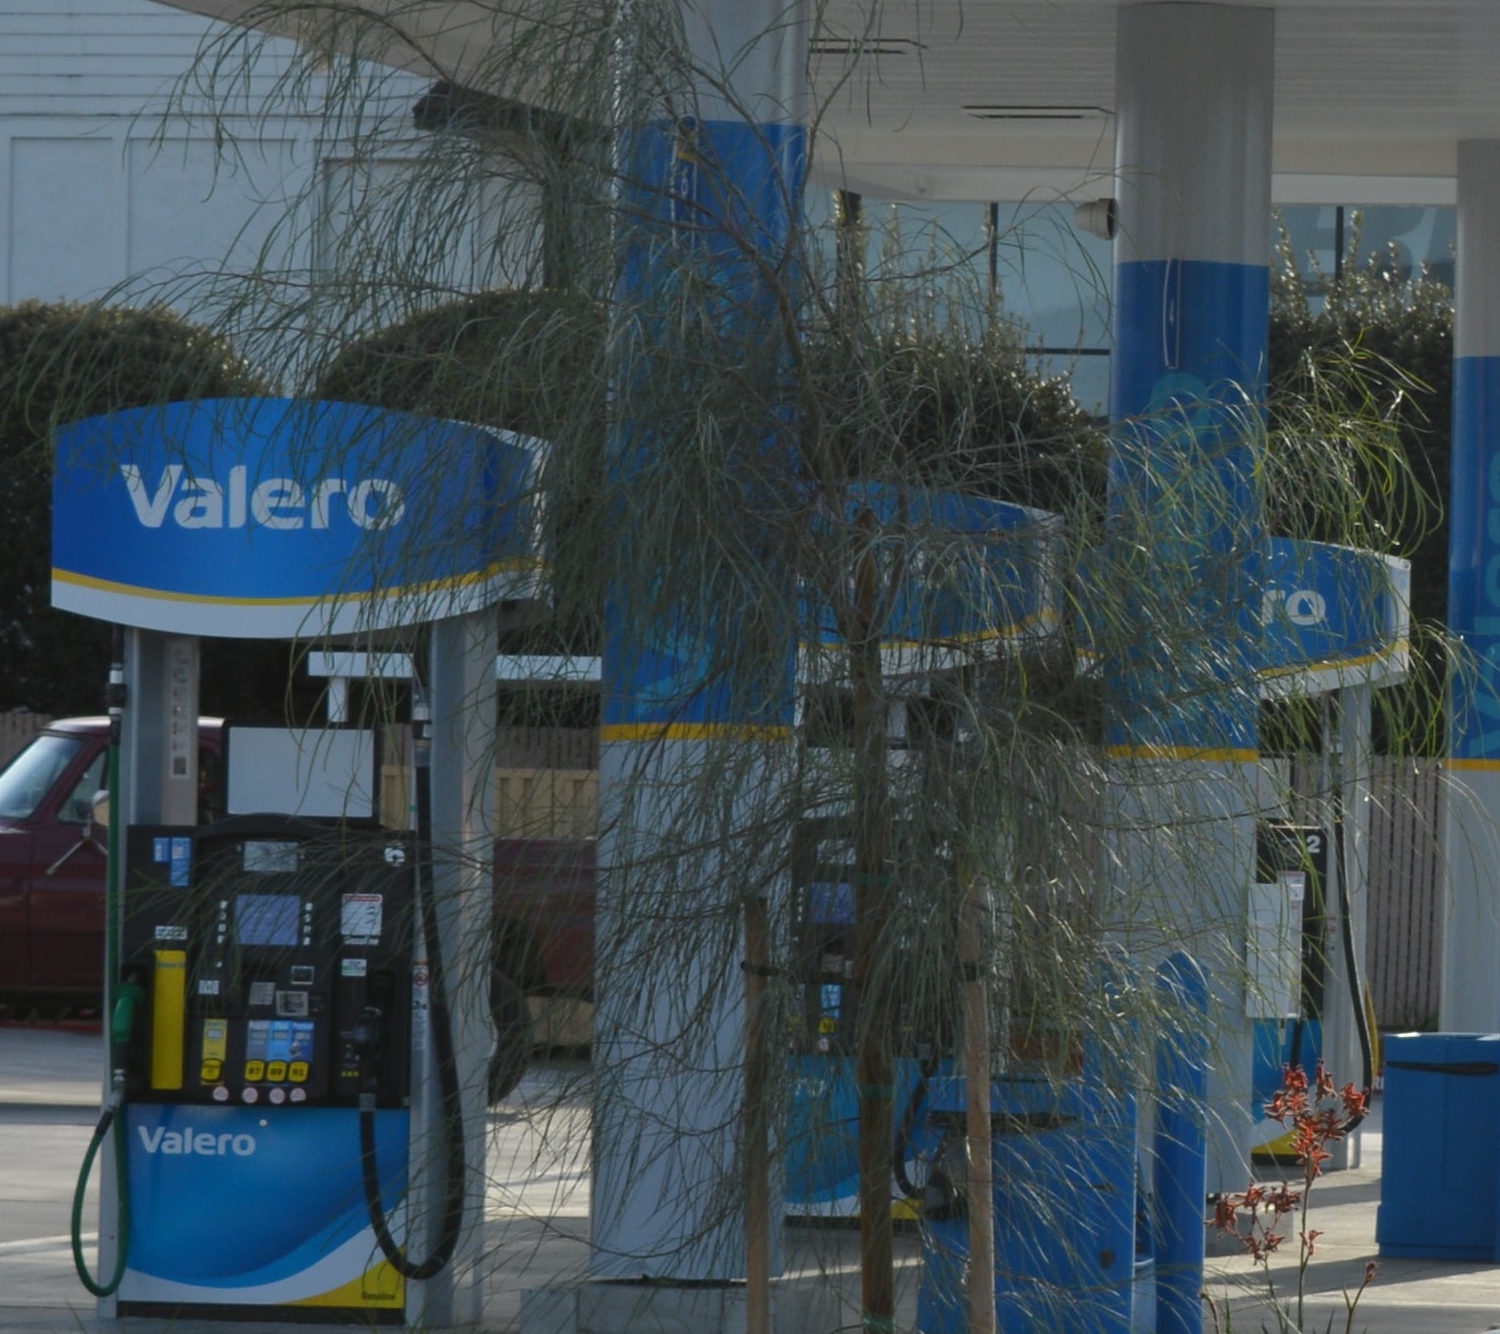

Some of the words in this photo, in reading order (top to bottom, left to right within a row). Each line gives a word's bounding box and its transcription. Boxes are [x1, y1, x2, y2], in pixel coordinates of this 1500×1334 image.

[120, 463, 407, 531] Valero
[1306, 835, 1321, 854] 2
[137, 1125, 257, 1157] Valero
